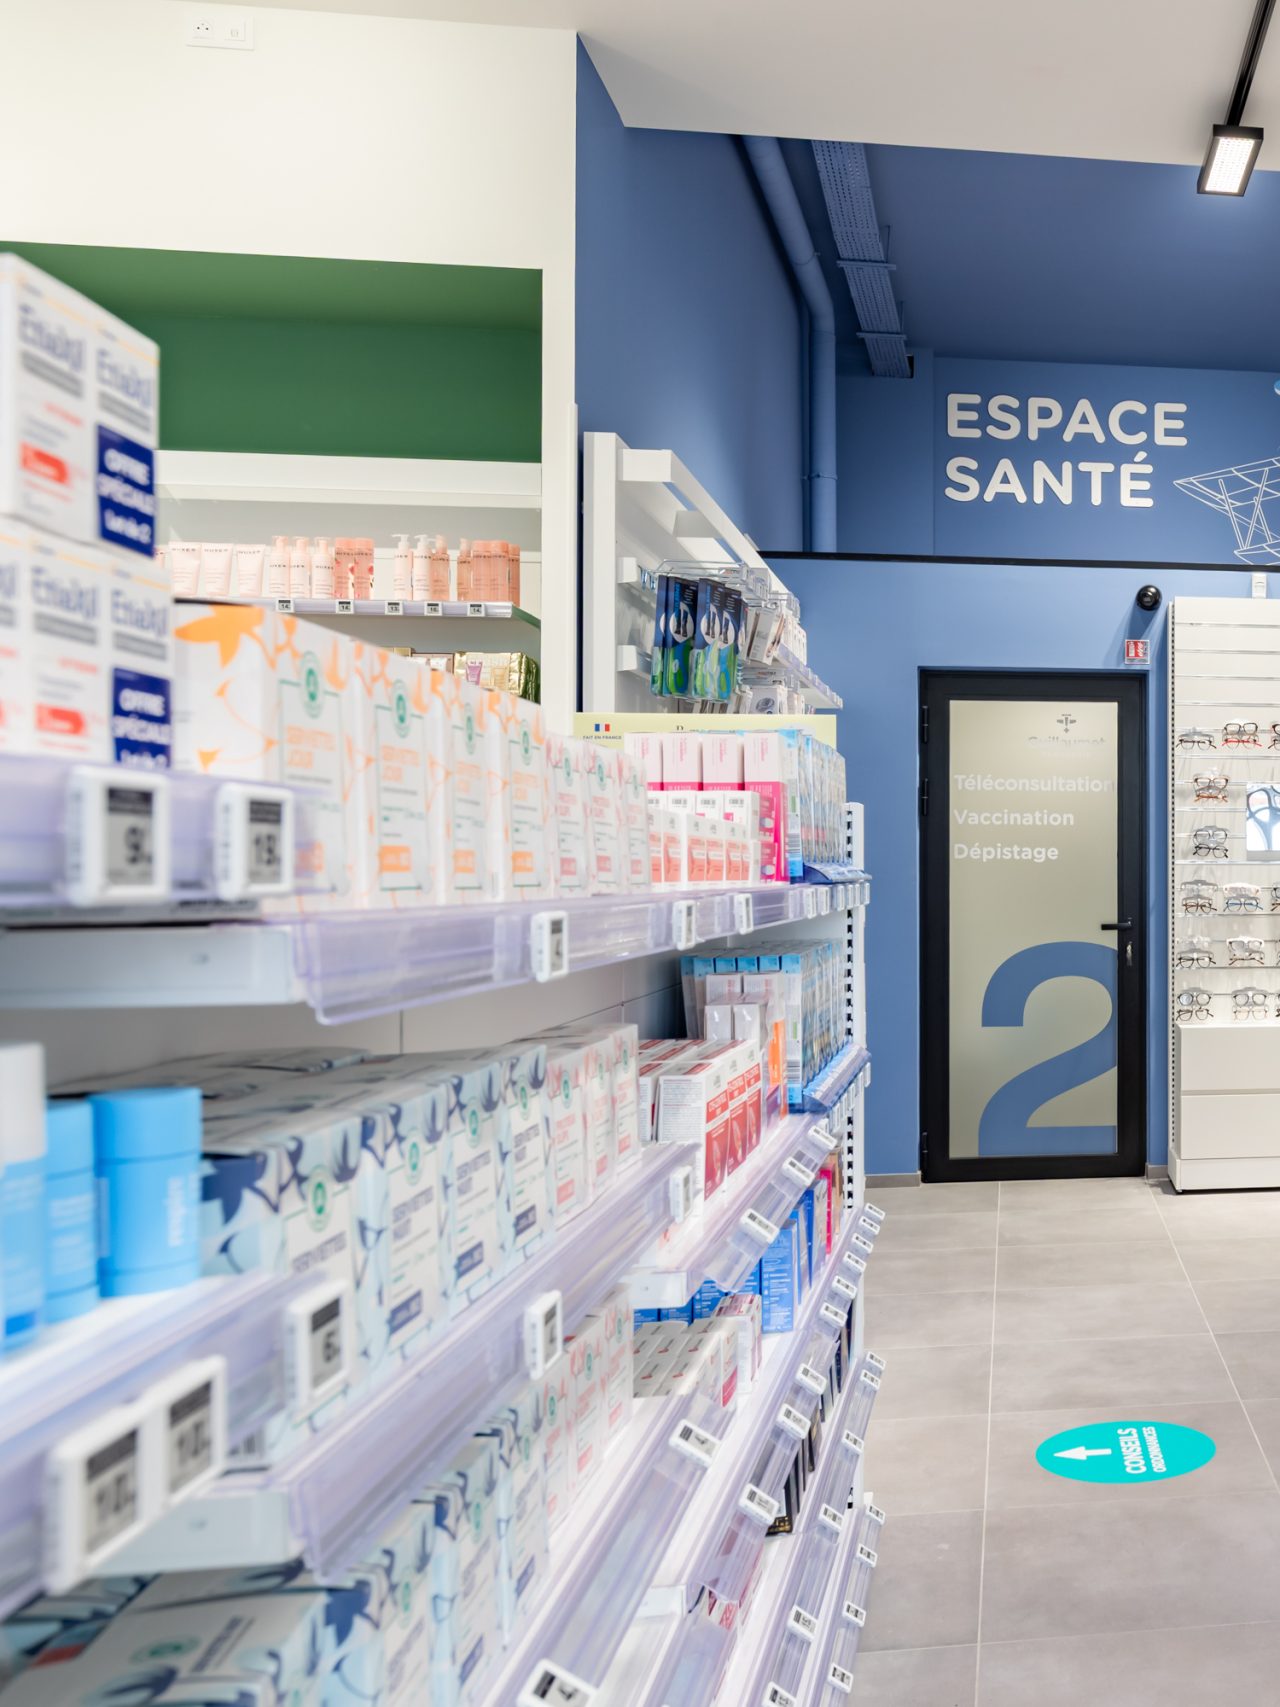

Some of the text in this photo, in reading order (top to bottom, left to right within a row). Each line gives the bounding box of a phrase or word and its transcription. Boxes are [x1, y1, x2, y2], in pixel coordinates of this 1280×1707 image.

[947, 393, 1188, 446] ESPACE
[944, 451, 1154, 508] SANTÉ
[953, 775, 1114, 792] Téléconsultation
[953, 809, 1074, 826] Vaccination
[953, 843, 1059, 862] Dépistage
[978, 941, 1118, 1157] 2
[1117, 1427, 1147, 1474] CONSEILS
